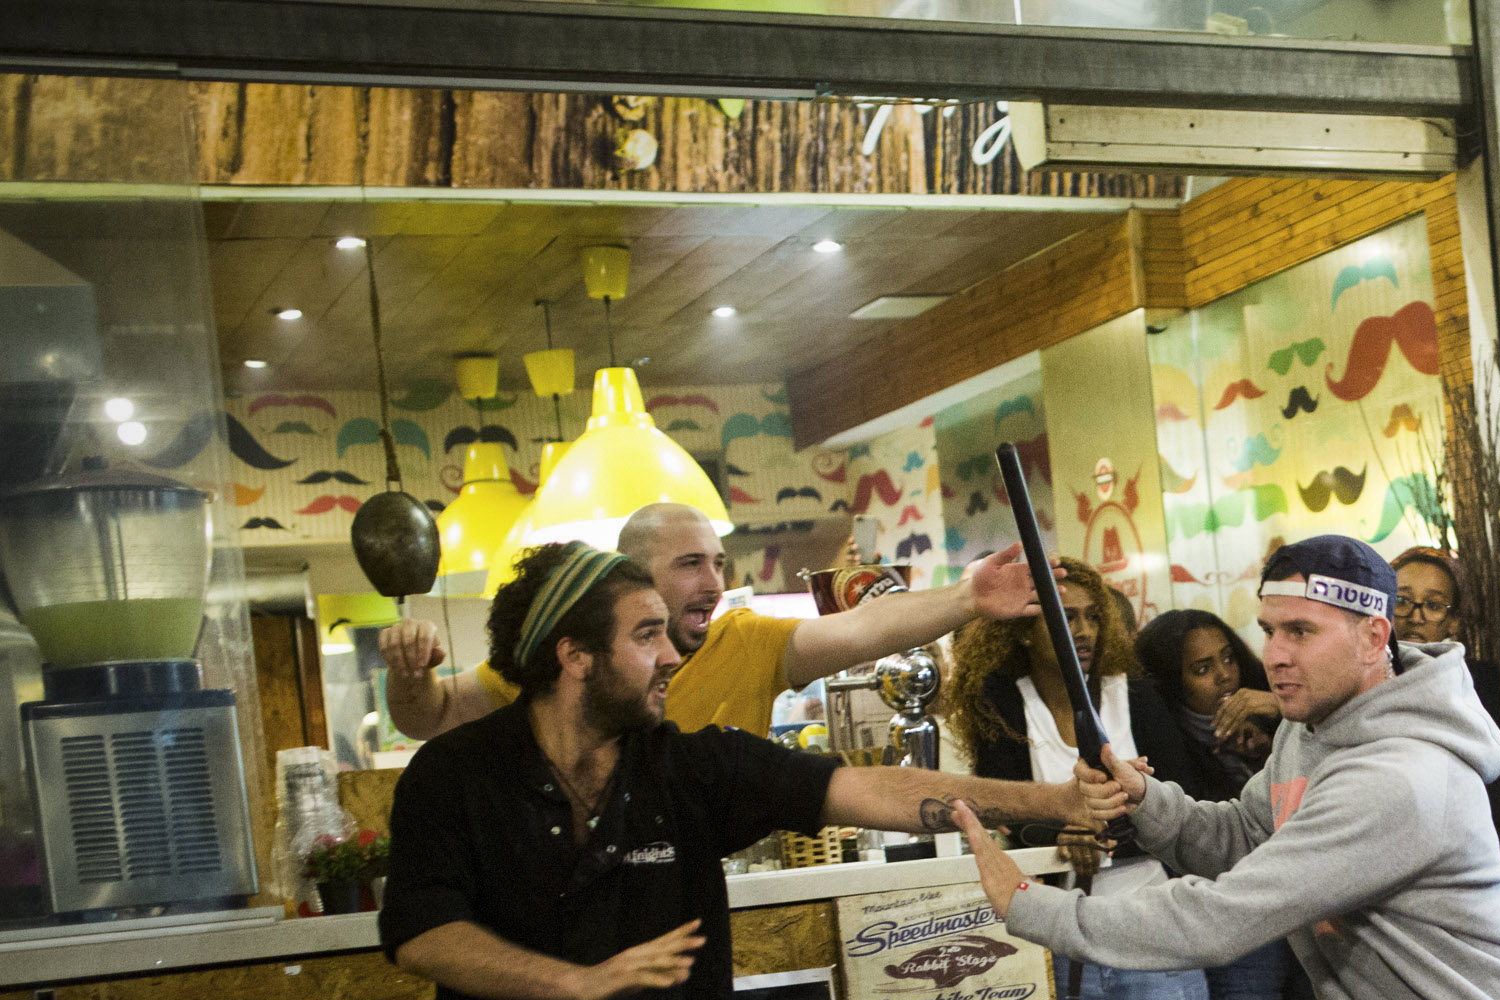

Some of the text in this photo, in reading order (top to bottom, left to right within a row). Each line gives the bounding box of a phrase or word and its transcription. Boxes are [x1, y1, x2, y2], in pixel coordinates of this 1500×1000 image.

[1312, 580, 1383, 612] משטרה
[902, 954, 998, 977] Rabbit Stage
